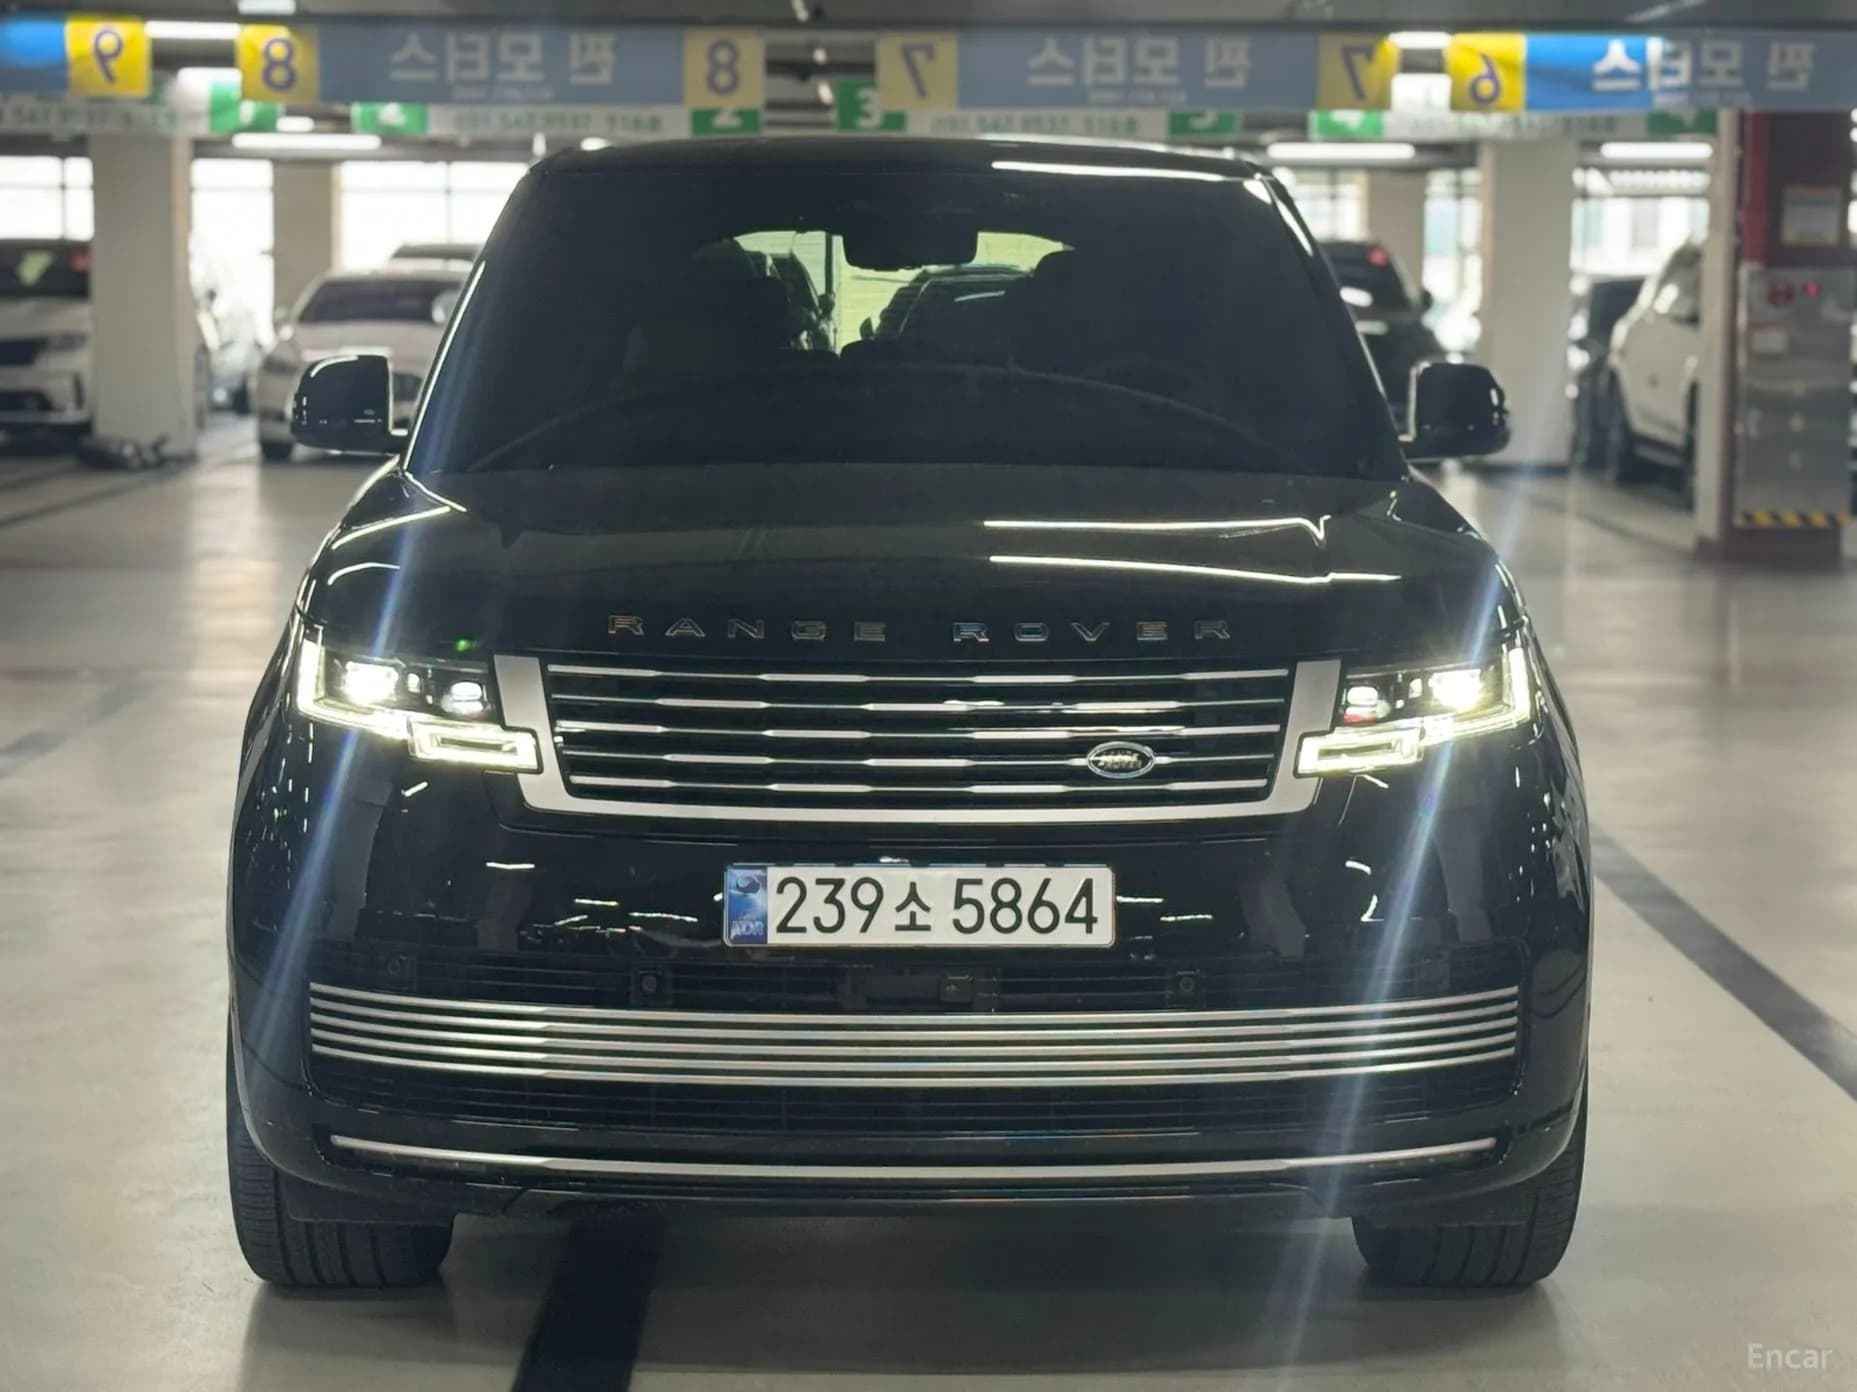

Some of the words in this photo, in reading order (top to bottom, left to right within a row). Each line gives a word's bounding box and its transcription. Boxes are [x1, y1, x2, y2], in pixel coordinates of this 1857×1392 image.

[608, 614, 886, 642] RANGE
[952, 620, 1231, 642] ROVER
[775, 876, 931, 934] 239소
[952, 877, 1098, 934] 5864
